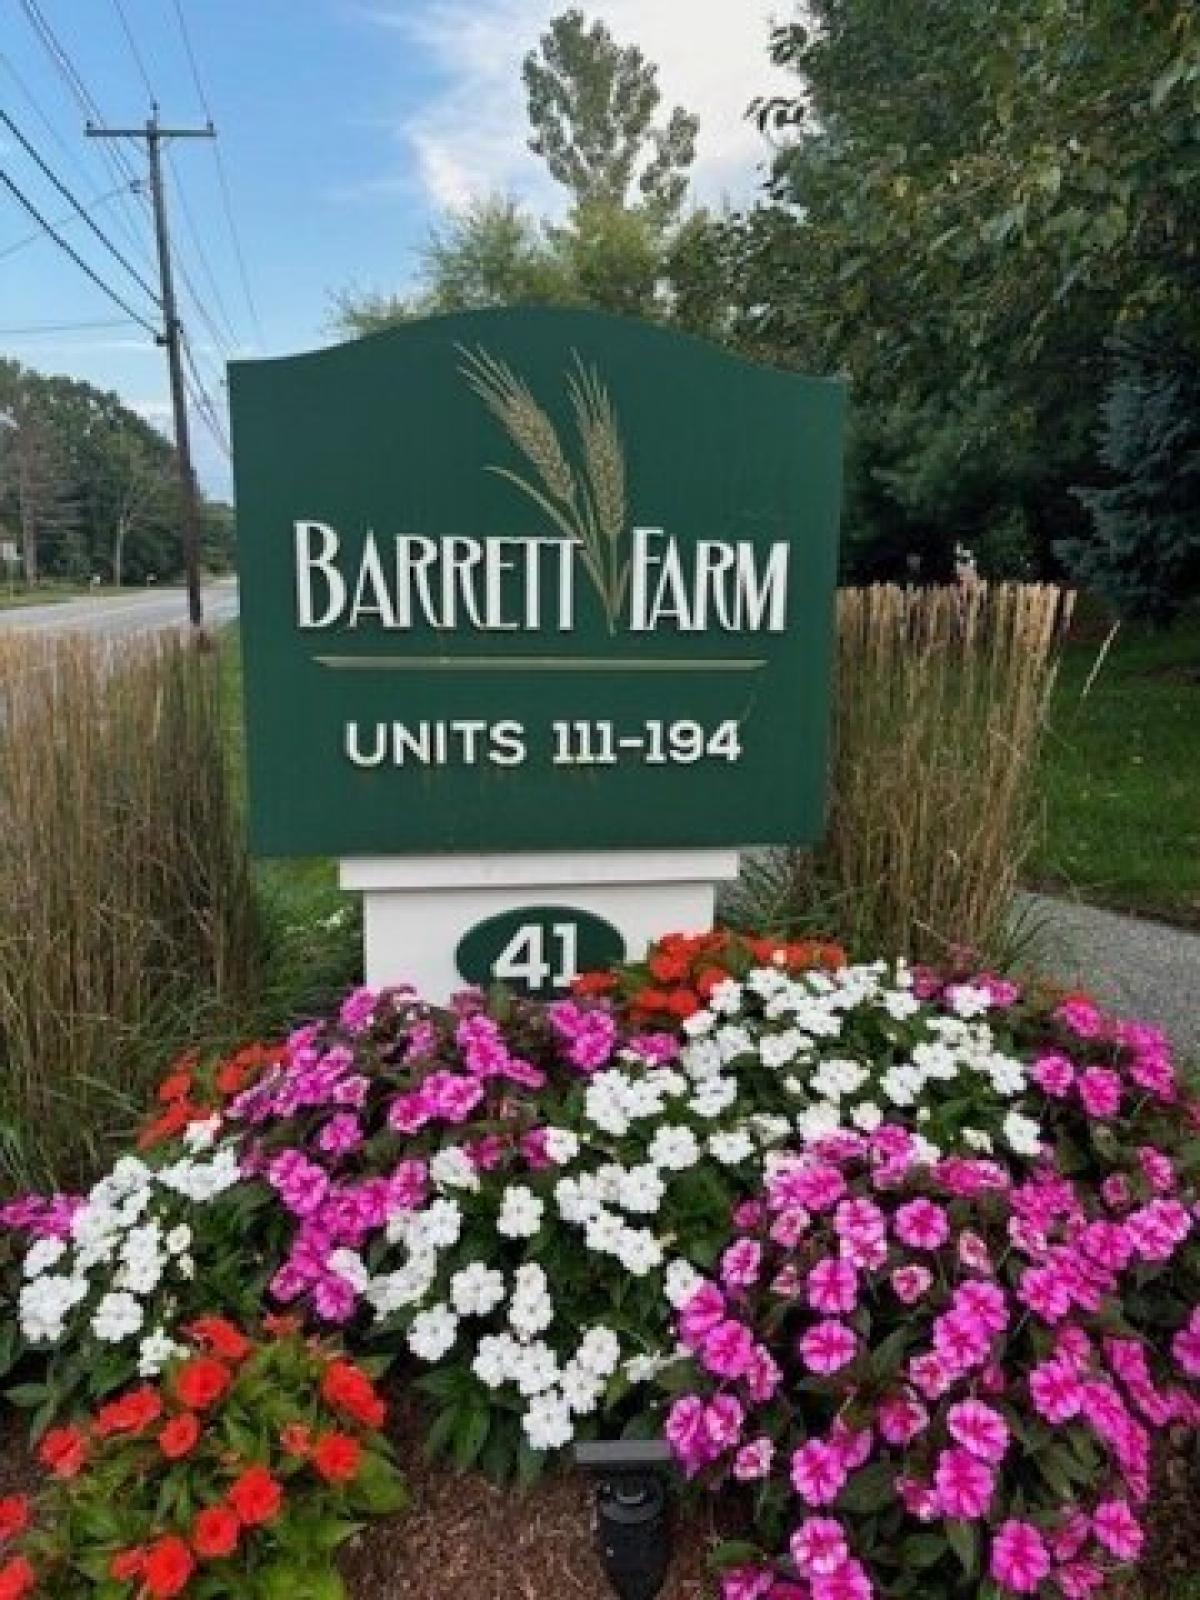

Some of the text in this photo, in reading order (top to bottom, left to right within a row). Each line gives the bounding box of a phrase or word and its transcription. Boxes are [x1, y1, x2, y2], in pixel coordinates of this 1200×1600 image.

[294, 520, 790, 632] BARRETT FARM
[345, 719, 742, 765] UNITS 111-194
[491, 922, 582, 990] 41
